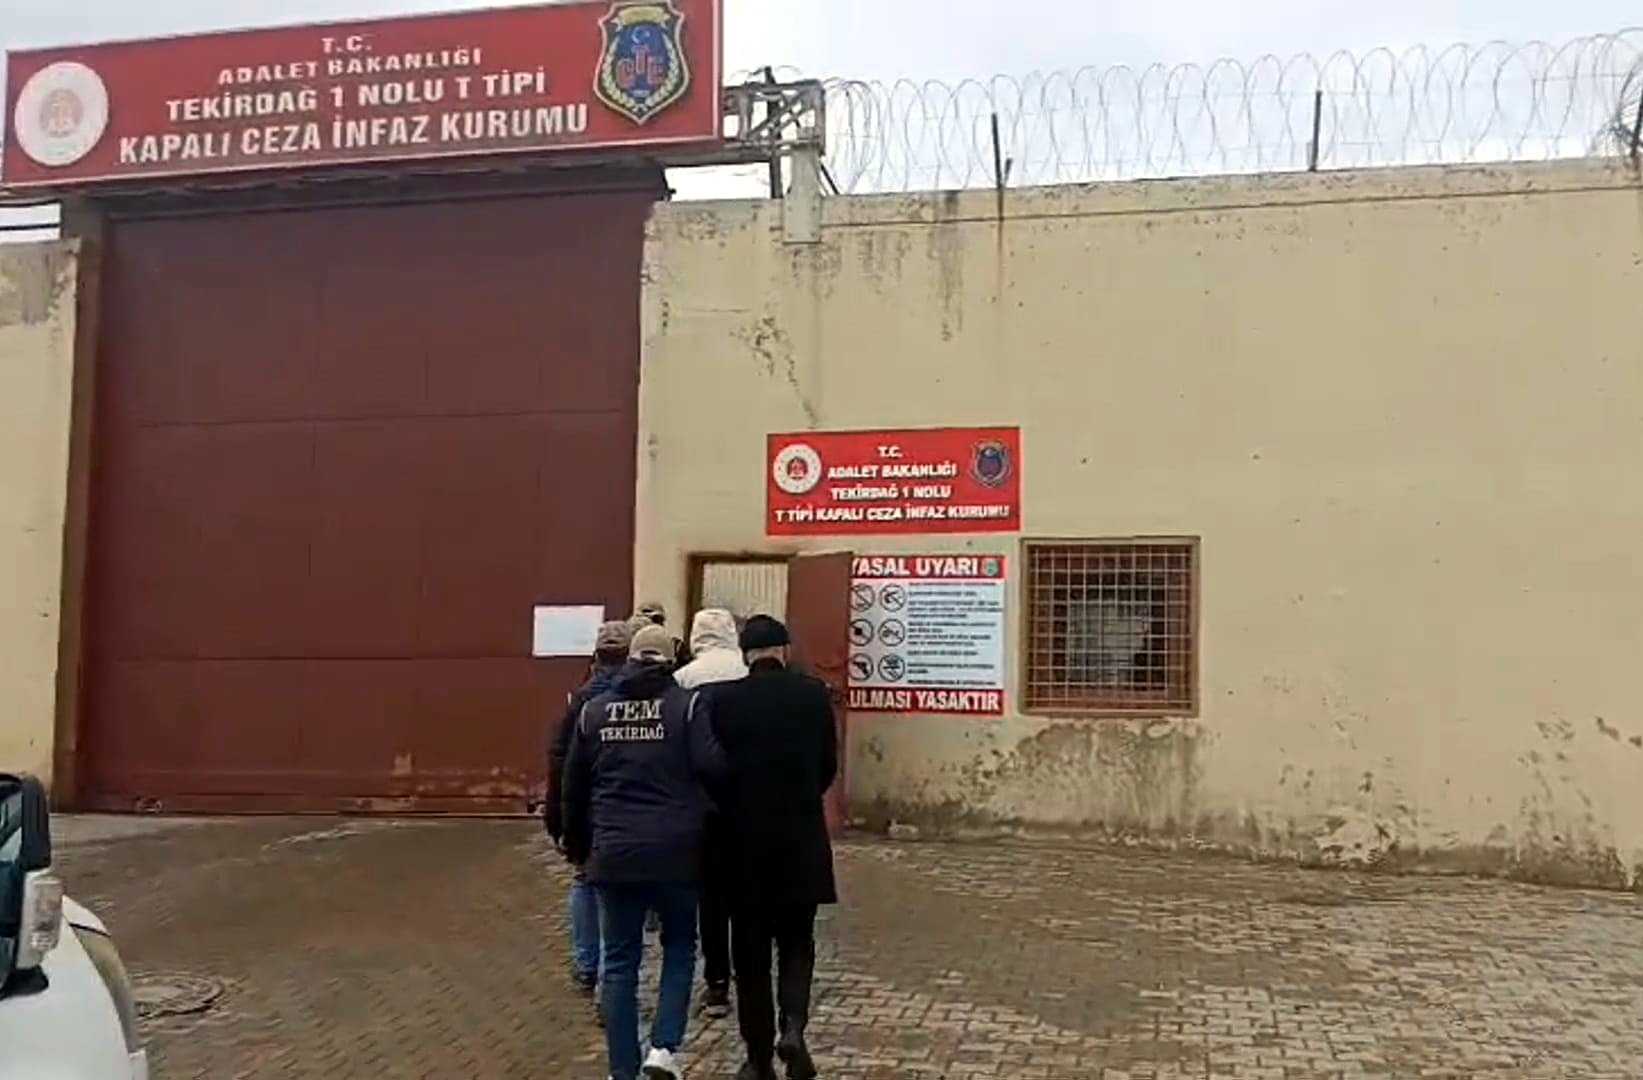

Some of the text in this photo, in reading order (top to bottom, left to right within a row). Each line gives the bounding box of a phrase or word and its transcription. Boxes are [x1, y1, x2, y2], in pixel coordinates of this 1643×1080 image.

[322, 35, 372, 53] T.C.
[217, 45, 482, 85] ADALET BAKANLIĞI
[166, 66, 545, 121] TEKİRDAĞ 1 NOLU T TİPİ
[119, 103, 588, 164] KAPALI CEZA İNFAZ KURUMU
[878, 446, 902, 457] T.C.
[827, 462, 957, 479] ADALET BAKANLIĞI
[831, 485, 951, 500] TEKİRDAĞ 1 NOLU
[776, 504, 1009, 522] T TİPİ KAPALI CEZA İNFAZ KURUMU
[915, 557, 978, 576] UYARI
[605, 699, 664, 721] TEM
[915, 691, 999, 711] YASAKTIR
[599, 723, 664, 742] TEKİRDAĞ
